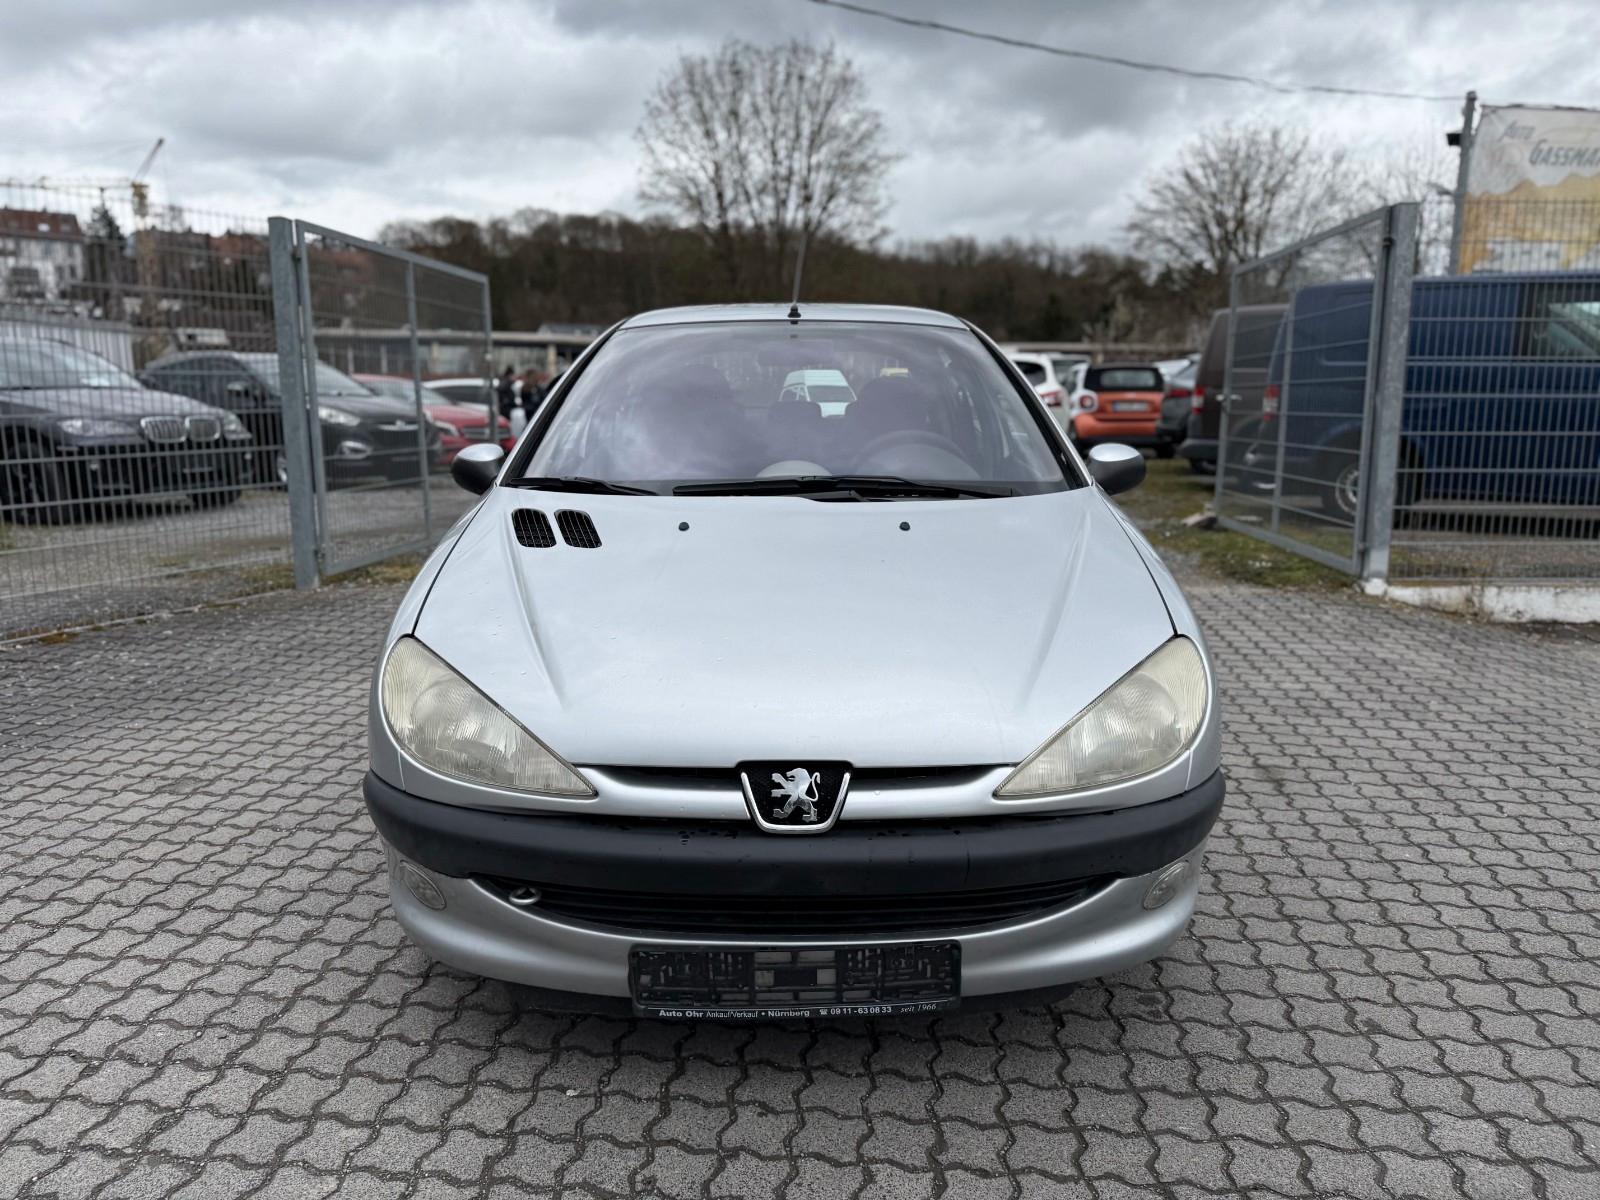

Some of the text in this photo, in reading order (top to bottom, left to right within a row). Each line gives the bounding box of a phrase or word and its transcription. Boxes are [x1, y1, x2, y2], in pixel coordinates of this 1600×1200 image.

[659, 1009, 682, 1018] Auto
[685, 1010, 704, 1018] Ohr
[706, 1010, 759, 1018] Ankauf/Verkauf
[768, 1008, 810, 1018] Nürnberg
[900, 1005, 915, 1013] seit
[917, 1003, 937, 1012] 1966
